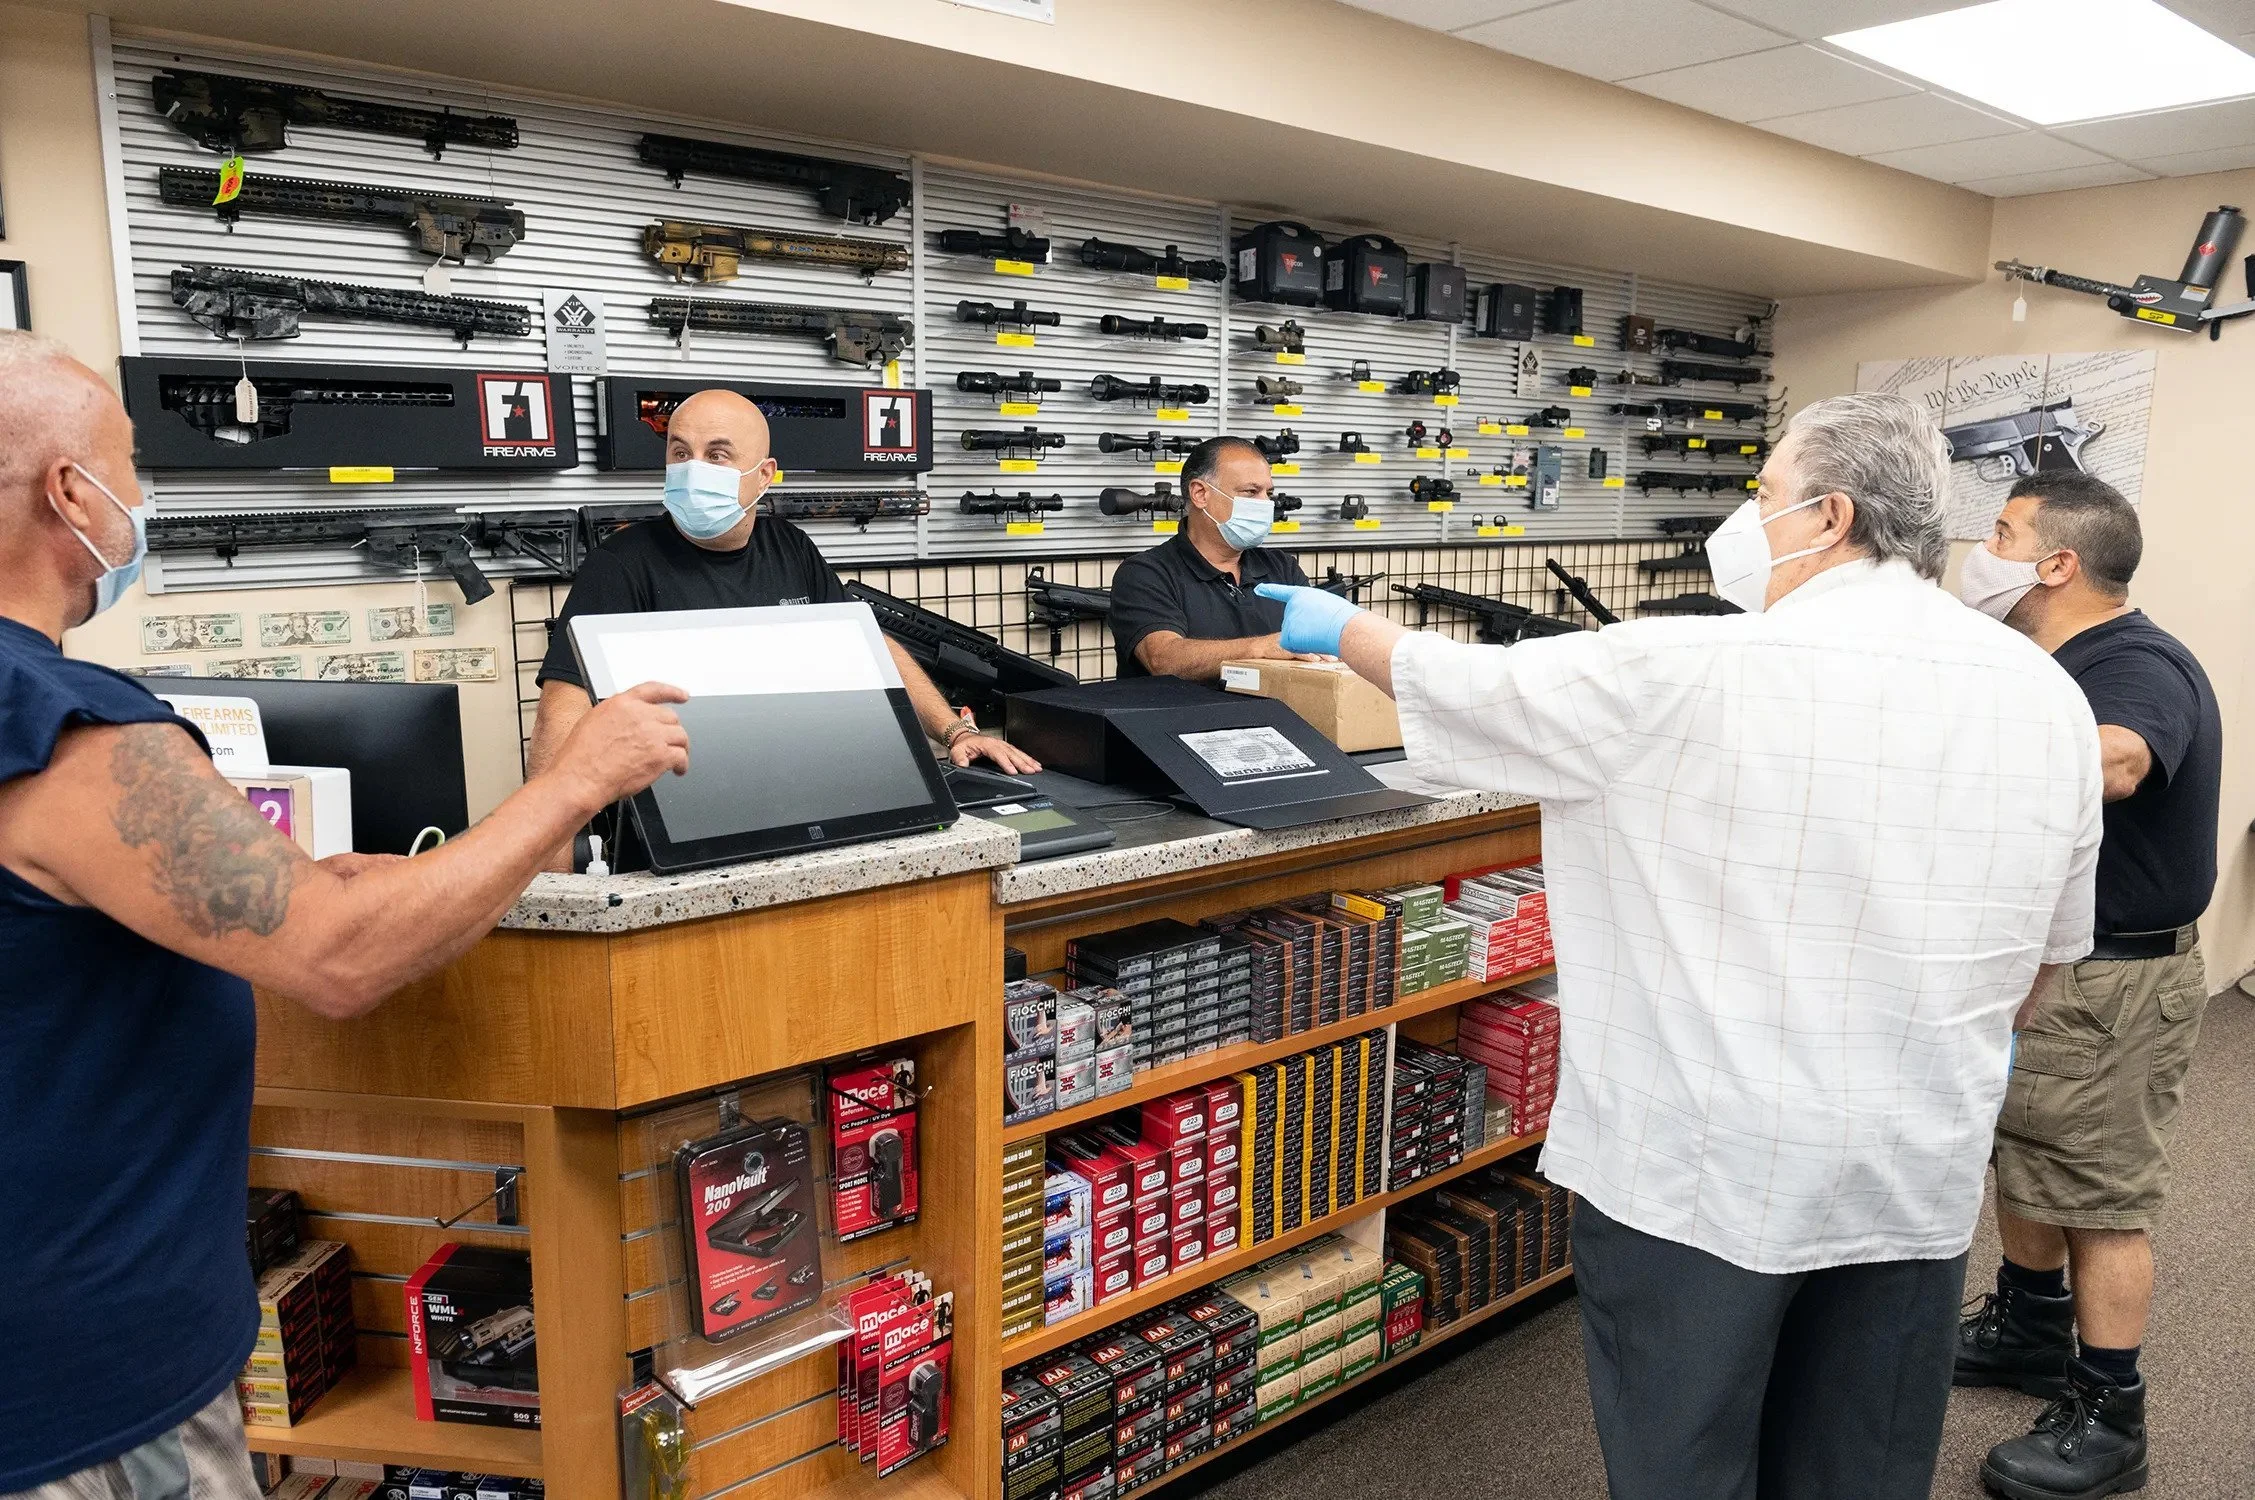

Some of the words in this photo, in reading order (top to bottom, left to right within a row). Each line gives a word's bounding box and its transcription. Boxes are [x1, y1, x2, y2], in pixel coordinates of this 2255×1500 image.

[1981, 360, 2040, 394] People
[483, 446, 557, 457] FIREARMS
[864, 453, 917, 462] FIREARMS
[183, 707, 254, 721] FIREARMS
[1223, 768, 1264, 777] GUNS
[1266, 762, 1310, 772] CABOT
[1413, 897, 1438, 907] MAGTECH
[1440, 933, 1466, 943] MAGTECH
[1439, 960, 1464, 971] MAGTECH
[840, 1107, 864, 1117] defense
[1221, 1105, 1233, 1114] .223
[850, 1118, 870, 1128] Pepper
[1184, 1116, 1198, 1125] .223
[1018, 1149, 1032, 1161] SLAM
[1219, 1148, 1232, 1157] .223
[1184, 1161, 1197, 1169] .223
[839, 1180, 853, 1191] SPORT
[853, 1176, 868, 1187] MODEL
[1147, 1173, 1160, 1182] .223
[704, 1169, 768, 1203] NanoVault
[1018, 1178, 1032, 1191] SLAM
[1109, 1186, 1123, 1195] .223
[1219, 1189, 1231, 1198] .223
[705, 1197, 731, 1216] 200
[1184, 1202, 1197, 1211] .223
[1018, 1207, 1032, 1220] SLAM
[1147, 1216, 1161, 1225] .223
[1110, 1230, 1124, 1239] .223
[1219, 1230, 1231, 1239] .223
[1018, 1235, 1032, 1248] SLAM
[1184, 1243, 1197, 1252] .223
[1148, 1258, 1162, 1267] .223
[1018, 1264, 1031, 1276] SLAM
[1111, 1273, 1124, 1282] .223
[1381, 1271, 1418, 1290] ESTATE
[1017, 1293, 1031, 1306] SLAM
[1347, 1285, 1378, 1305] Remington
[431, 1314, 454, 1322] WHITE
[719, 1328, 735, 1338] AUTO
[741, 1319, 757, 1330] HOME
[764, 1306, 788, 1320] FIREARM
[793, 1297, 812, 1308] TRAVEL
[1194, 1305, 1216, 1319] AA
[1304, 1304, 1338, 1324] Remington
[409, 1296, 422, 1354] INFORCE
[860, 1304, 908, 1334] mace
[1017, 1321, 1031, 1333] SLAM
[1148, 1326, 1170, 1340] AA
[1346, 1322, 1377, 1343] Remington
[885, 1317, 930, 1350] mace
[1263, 1324, 1298, 1344] Remington
[885, 1344, 906, 1357] defense
[1098, 1347, 1120, 1363] AA
[1217, 1344, 1230, 1355] AA
[1304, 1341, 1337, 1362] Remington
[885, 1362, 893, 1370] OC
[893, 1356, 911, 1367] Pepper
[913, 1350, 921, 1358] UV
[921, 1345, 931, 1354] Dye
[1045, 1366, 1069, 1385] AA
[1170, 1366, 1182, 1377] AA
[1261, 1362, 1295, 1382] Remington
[1344, 1359, 1376, 1380] Remington
[1120, 1388, 1133, 1400] AA
[1217, 1384, 1229, 1395] AA
[1303, 1379, 1336, 1400] Remington
[860, 1401, 873, 1411] SPORT
[1169, 1406, 1182, 1418] AA
[1260, 1399, 1295, 1421] Remington
[880, 1416, 895, 1428] SPORT
[895, 1411, 907, 1422] MODEL
[1120, 1428, 1133, 1439] AA
[1216, 1423, 1228, 1434] AA
[1011, 1435, 1026, 1450] AA
[861, 1452, 876, 1463] CAUTION
[1168, 1446, 1181, 1457] AA
[879, 1466, 894, 1478] CAUTION
[1120, 1468, 1133, 1480] AA
